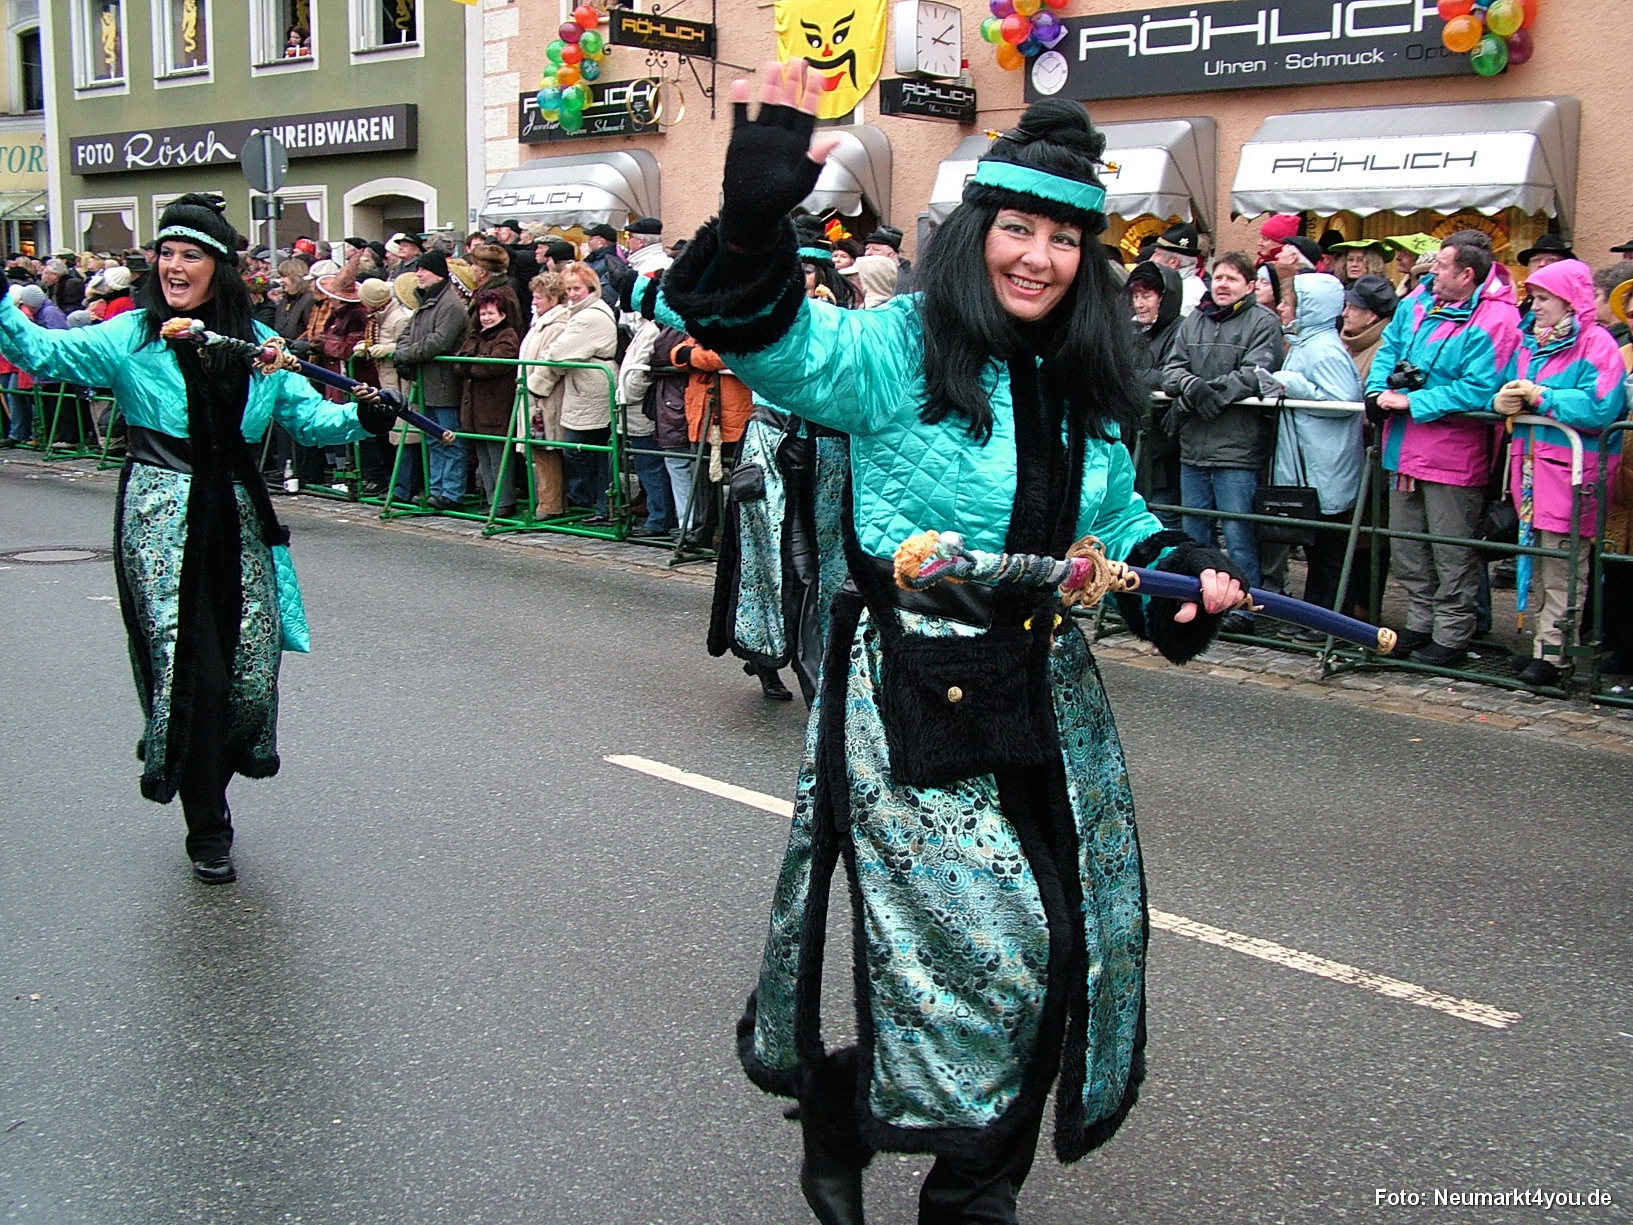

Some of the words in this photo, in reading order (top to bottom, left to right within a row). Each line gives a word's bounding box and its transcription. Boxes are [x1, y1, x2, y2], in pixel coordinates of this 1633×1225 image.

[621, 18, 705, 42] RÖHLICH
[1204, 60, 1266, 76] Uhren
[1285, 48, 1385, 69] Schmuck
[1405, 44, 1467, 62] Opt
[902, 82, 974, 102] RÖHLICH
[77, 143, 114, 166] FOTO
[123, 130, 237, 169] Rösch
[250, 115, 395, 149] HREIBWAREN
[0, 145, 48, 174] TOR
[1272, 151, 1477, 174] RÖHLICH
[485, 191, 583, 209] RÖHLICH
